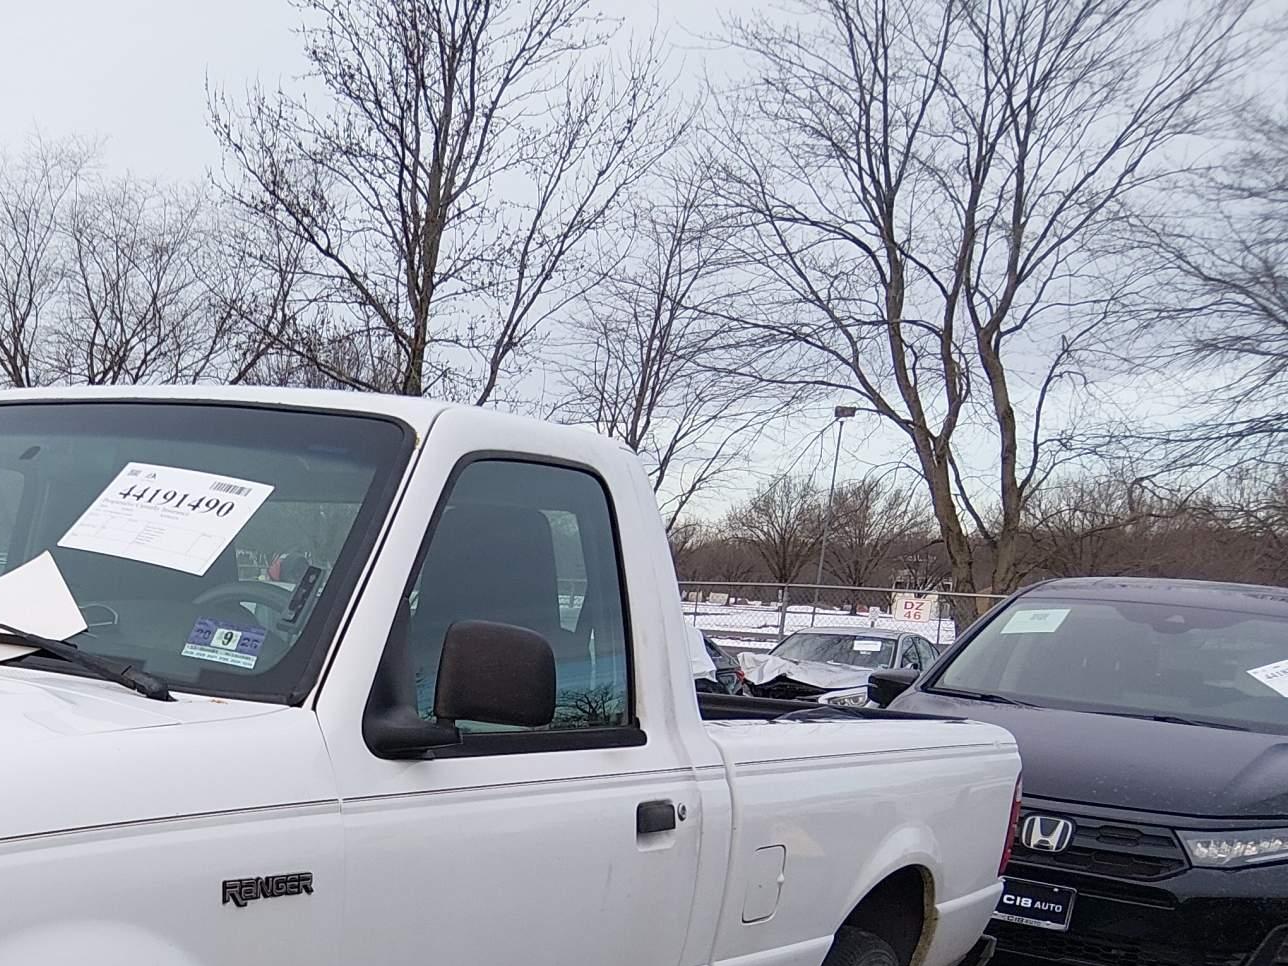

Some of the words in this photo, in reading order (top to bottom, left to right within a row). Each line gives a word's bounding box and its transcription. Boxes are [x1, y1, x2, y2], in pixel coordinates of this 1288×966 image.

[118, 484, 235, 518] 44191490
[903, 601, 925, 611] DZ
[903, 611, 921, 620] 46
[222, 631, 234, 646] 9
[222, 872, 314, 908] RANGER
[1034, 901, 1063, 913] AUTO
